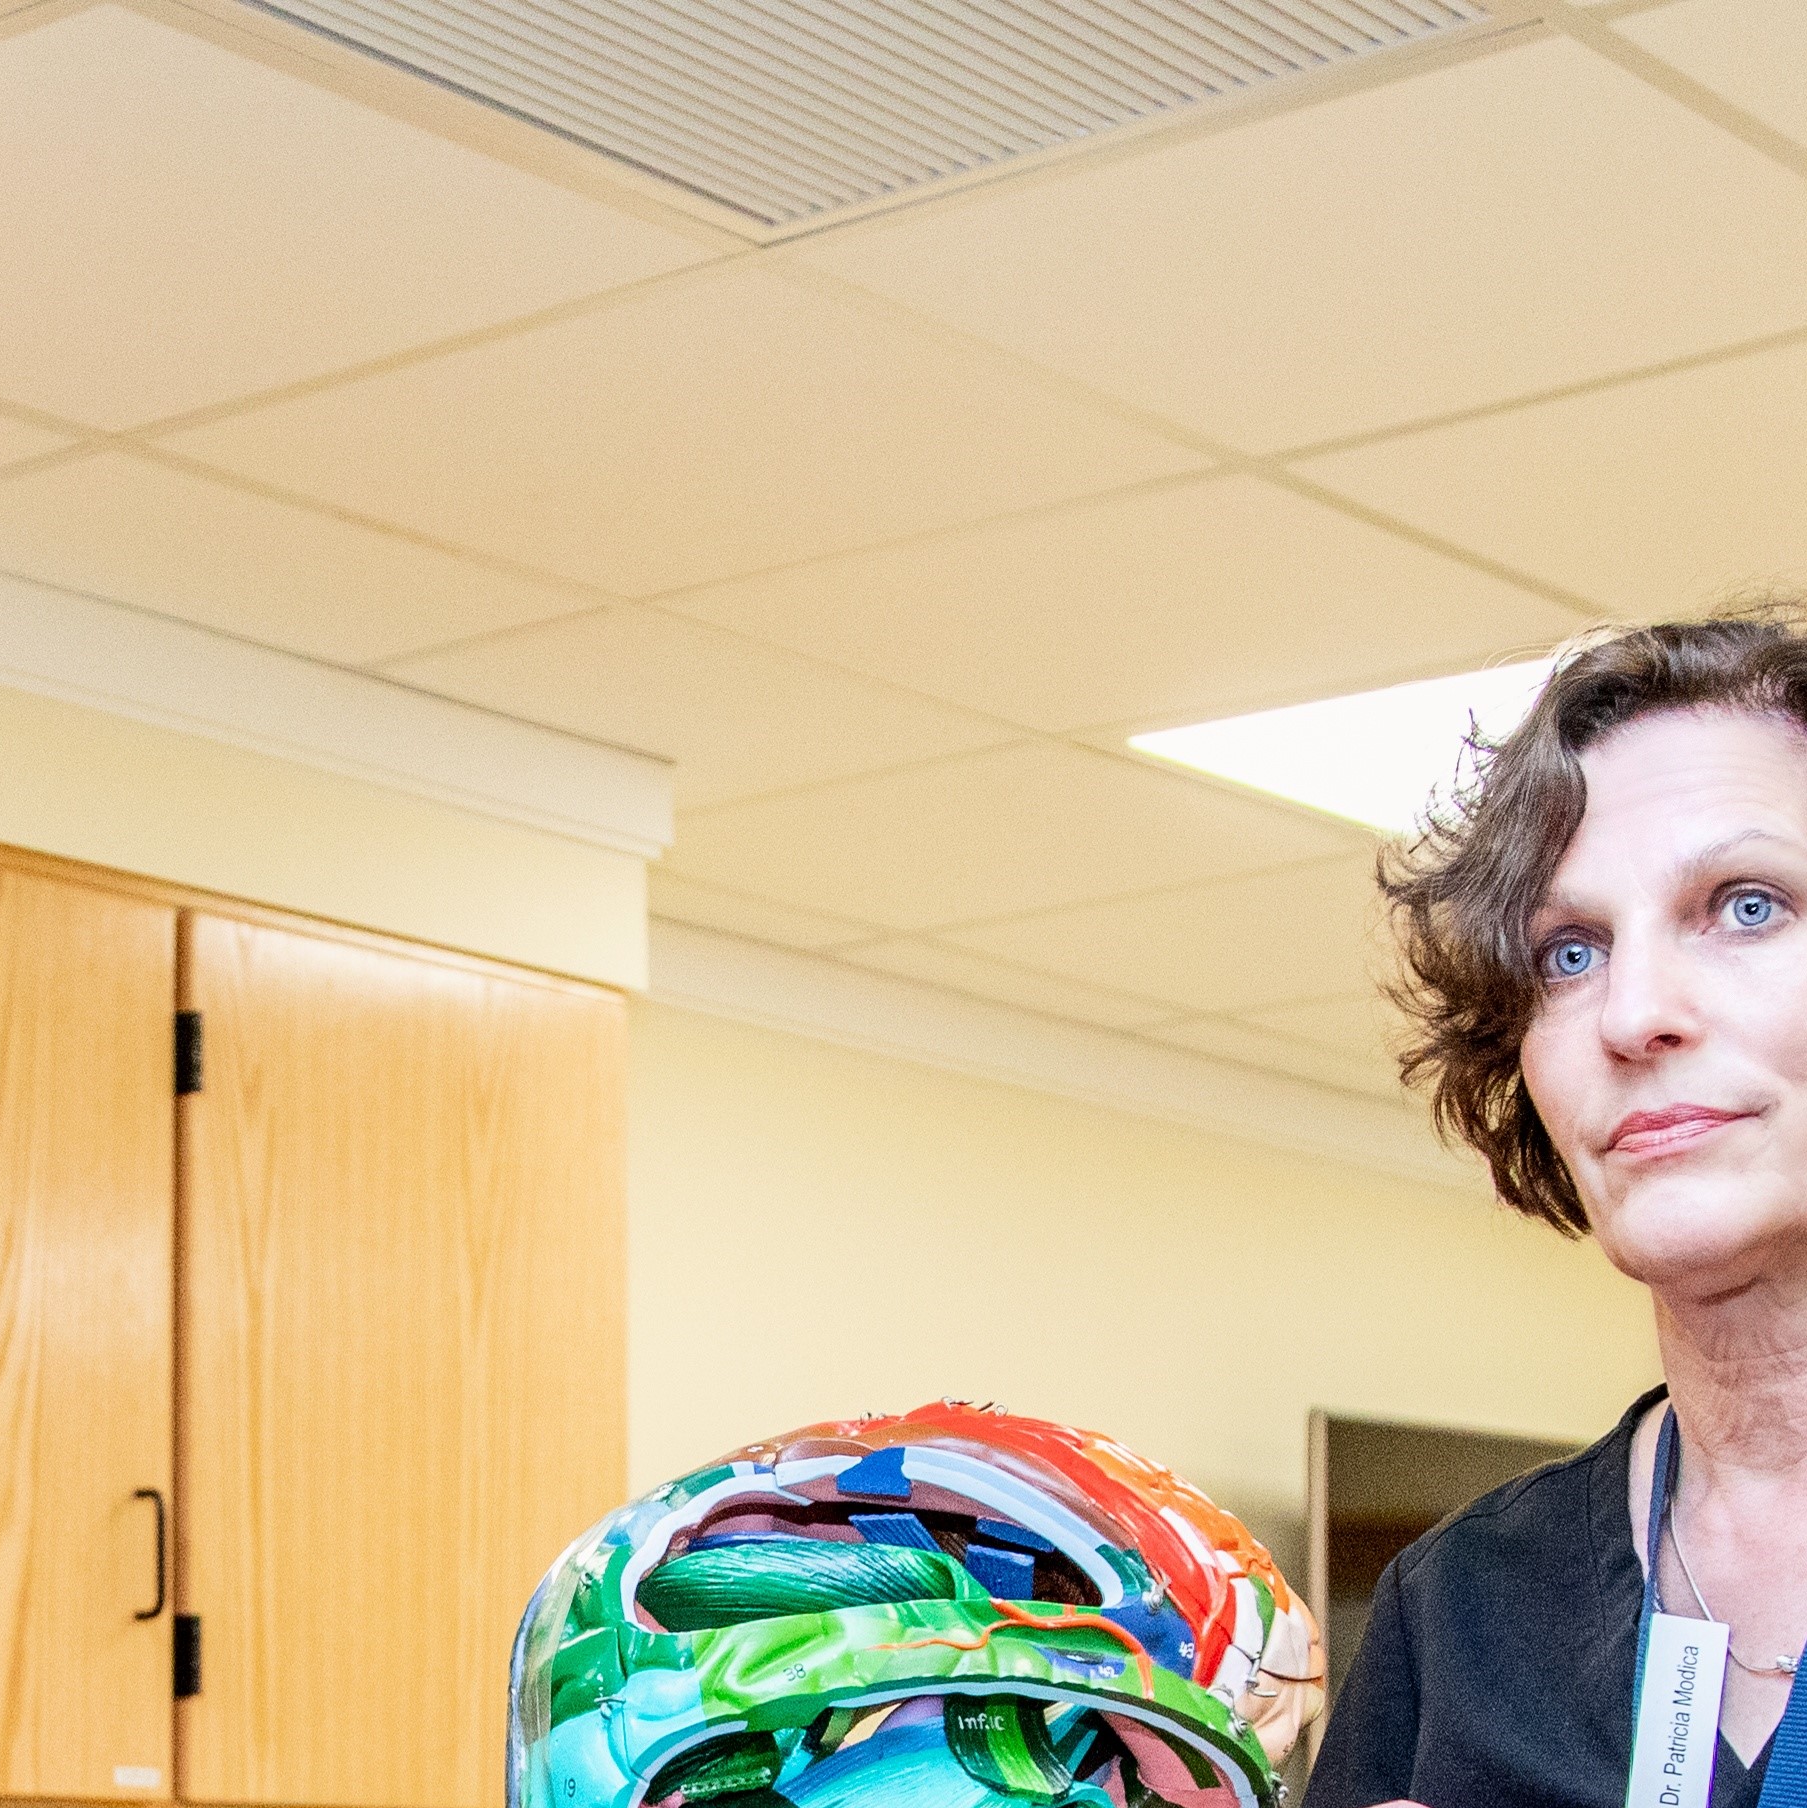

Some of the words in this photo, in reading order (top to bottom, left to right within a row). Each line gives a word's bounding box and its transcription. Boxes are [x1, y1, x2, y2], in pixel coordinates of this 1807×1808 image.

[782, 1662, 807, 1682] 38
[1672, 1644, 1700, 1707] Modica
[1663, 1711, 1691, 1776] Patricia
[563, 1777, 577, 1798] 19
[1659, 1782, 1682, 1807] Dr.
